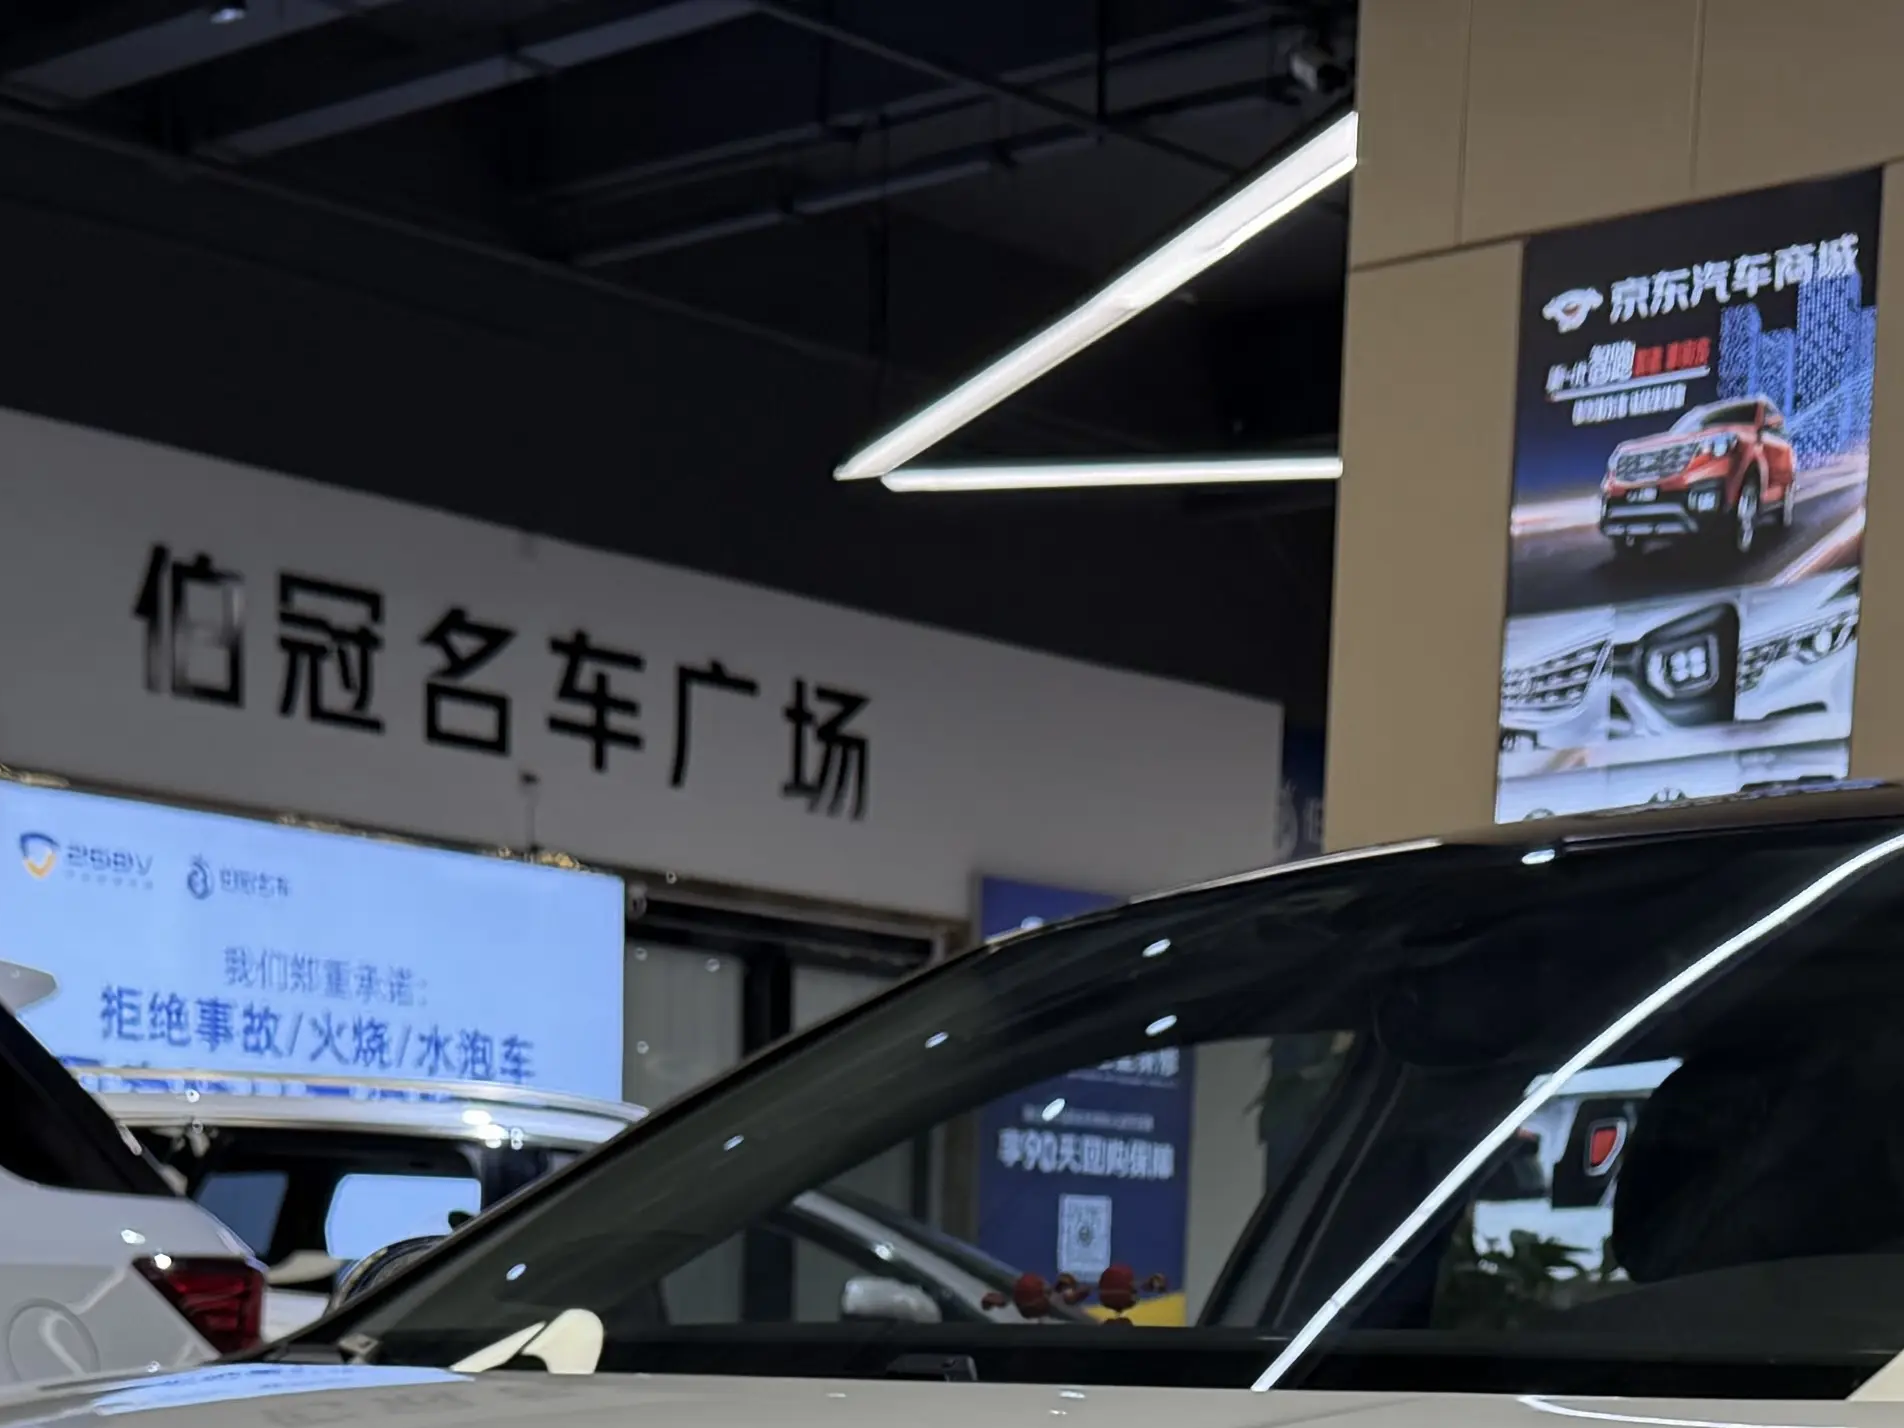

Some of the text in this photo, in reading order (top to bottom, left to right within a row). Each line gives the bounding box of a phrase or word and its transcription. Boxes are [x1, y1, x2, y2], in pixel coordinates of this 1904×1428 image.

[1610, 232, 1859, 325] 京东汽车商城
[132, 542, 872, 822] 伯冠名车广场
[99, 984, 539, 1085] 拒绝事故/火烧/水泡车
